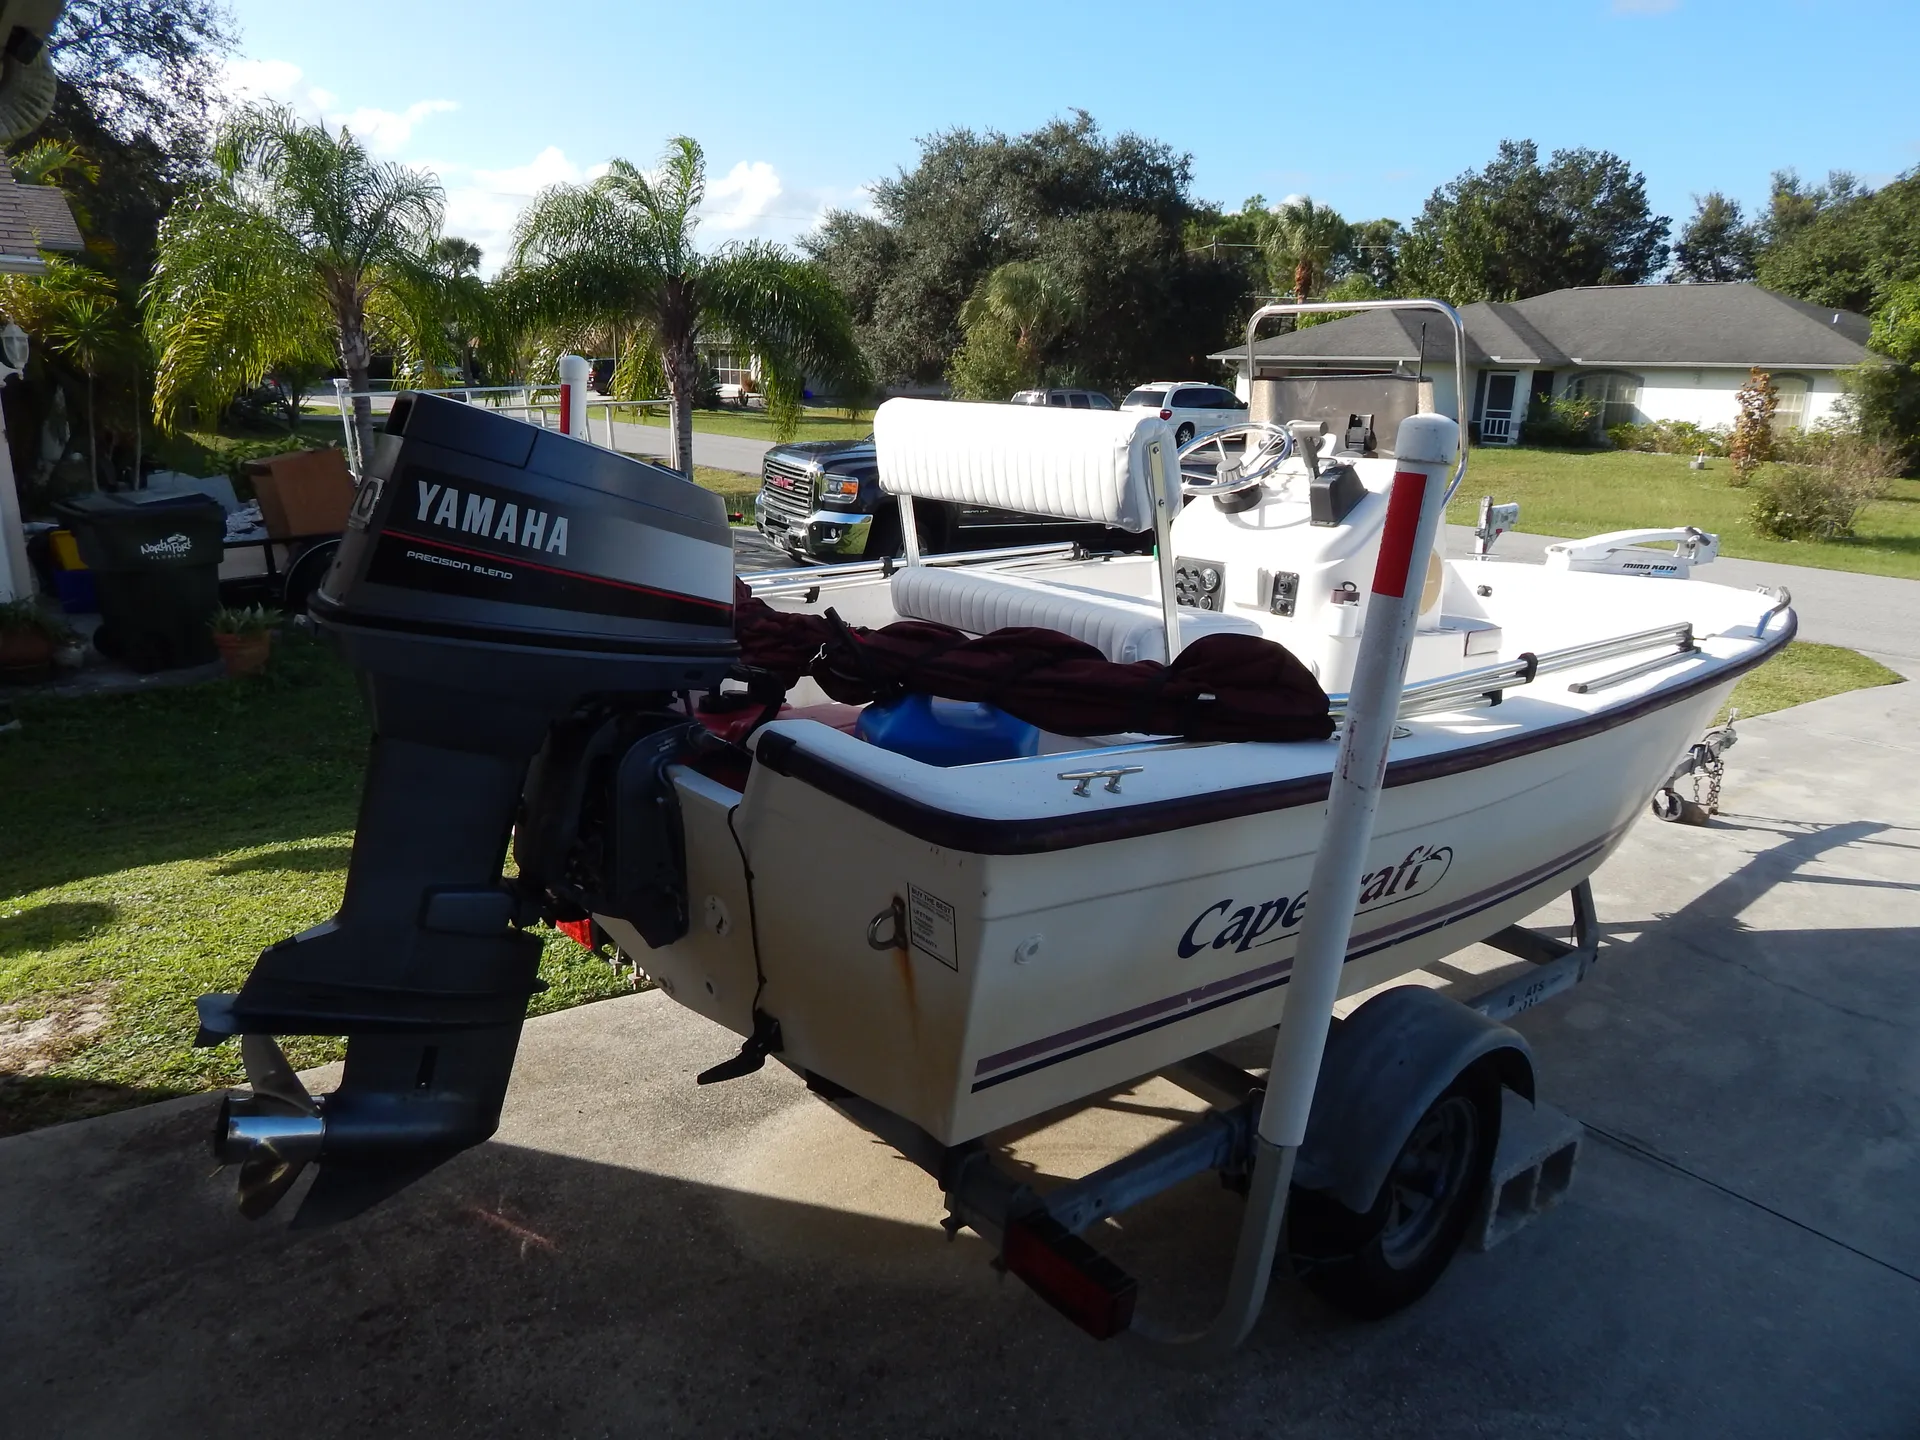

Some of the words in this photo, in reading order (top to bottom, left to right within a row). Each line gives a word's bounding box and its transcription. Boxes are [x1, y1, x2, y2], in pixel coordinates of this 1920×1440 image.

[773, 475, 795, 490] GMC
[417, 480, 569, 556] YAMAHA
[406, 550, 471, 571] PRECISION
[473, 565, 513, 580] BLEND
[935, 901, 951, 914] BEST
